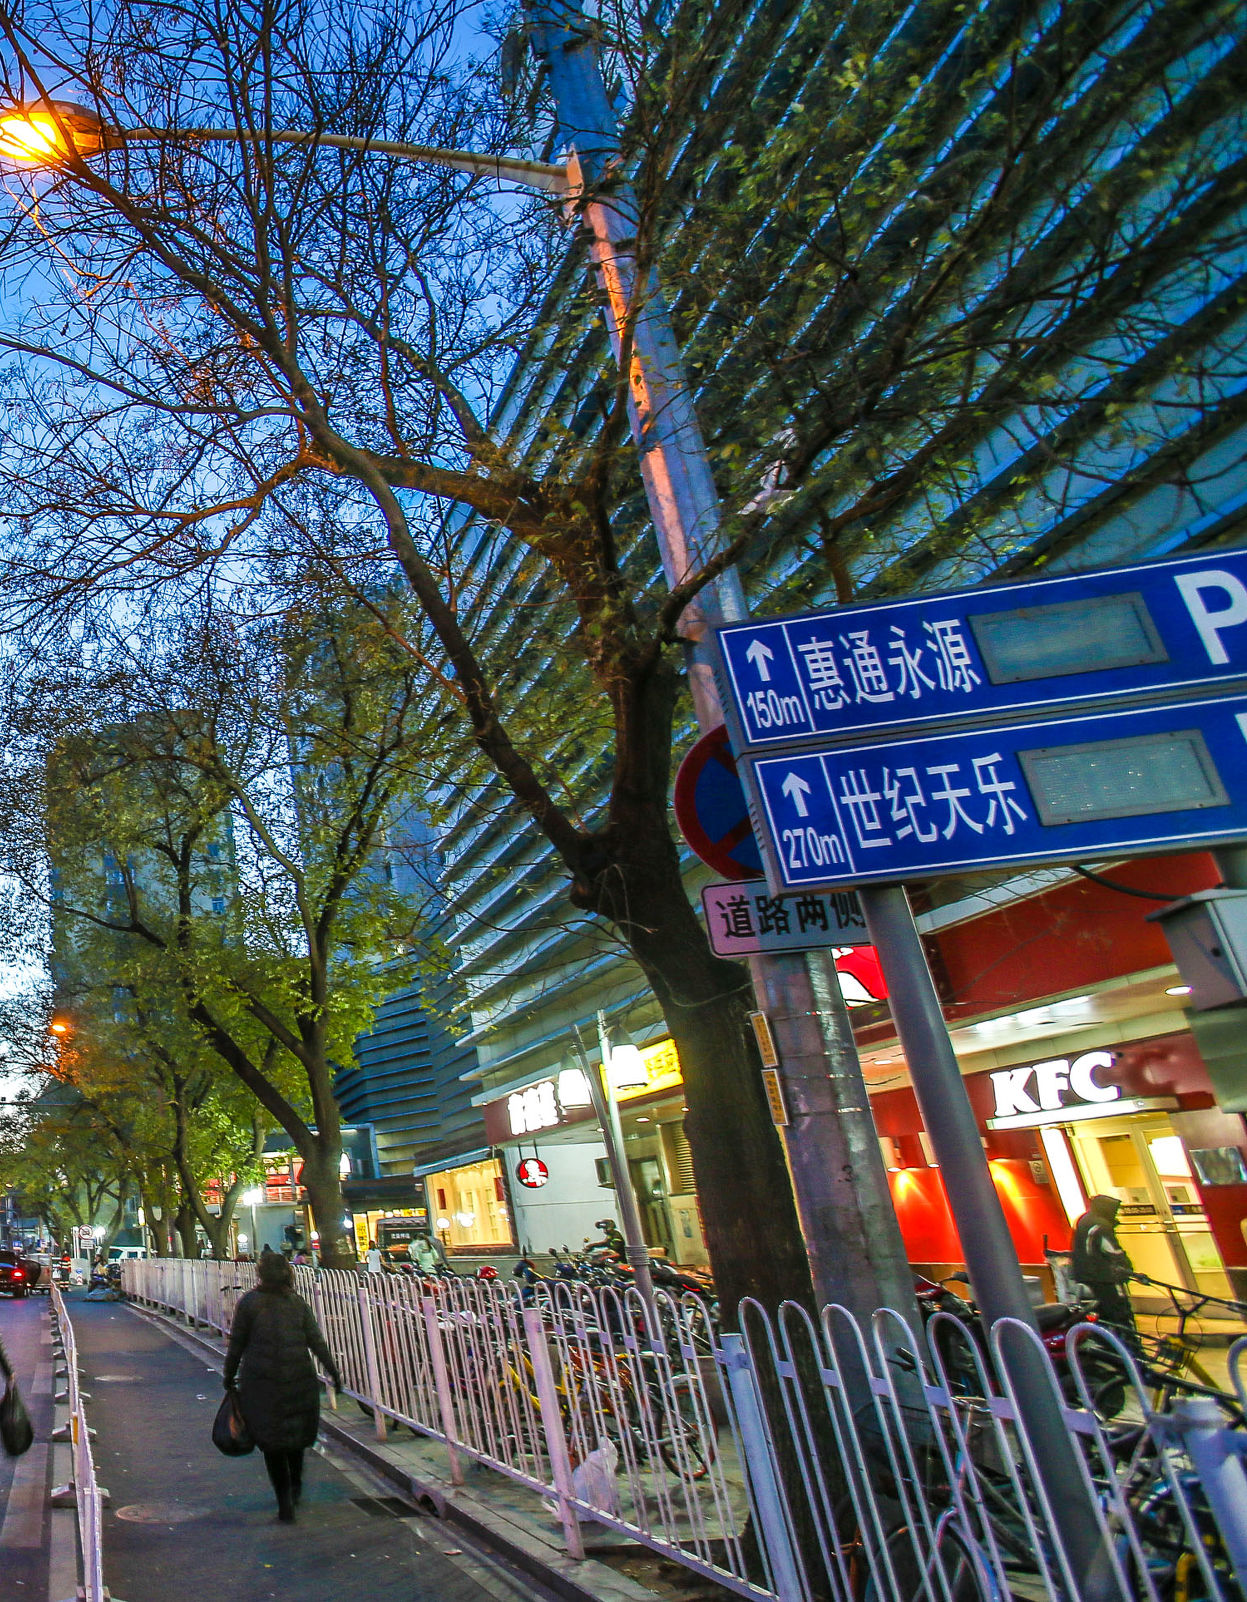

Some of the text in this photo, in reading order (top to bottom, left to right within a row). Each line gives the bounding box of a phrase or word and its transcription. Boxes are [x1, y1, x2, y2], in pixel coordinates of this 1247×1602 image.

[1174, 570, 1247, 665] P
[797, 618, 982, 711] 惠通永源
[746, 690, 805, 729] 150m
[840, 752, 1028, 850] 世纪天乐
[782, 827, 846, 869] 270m
[715, 892, 867, 938] 道路两侧
[989, 1050, 1121, 1118] KFC
